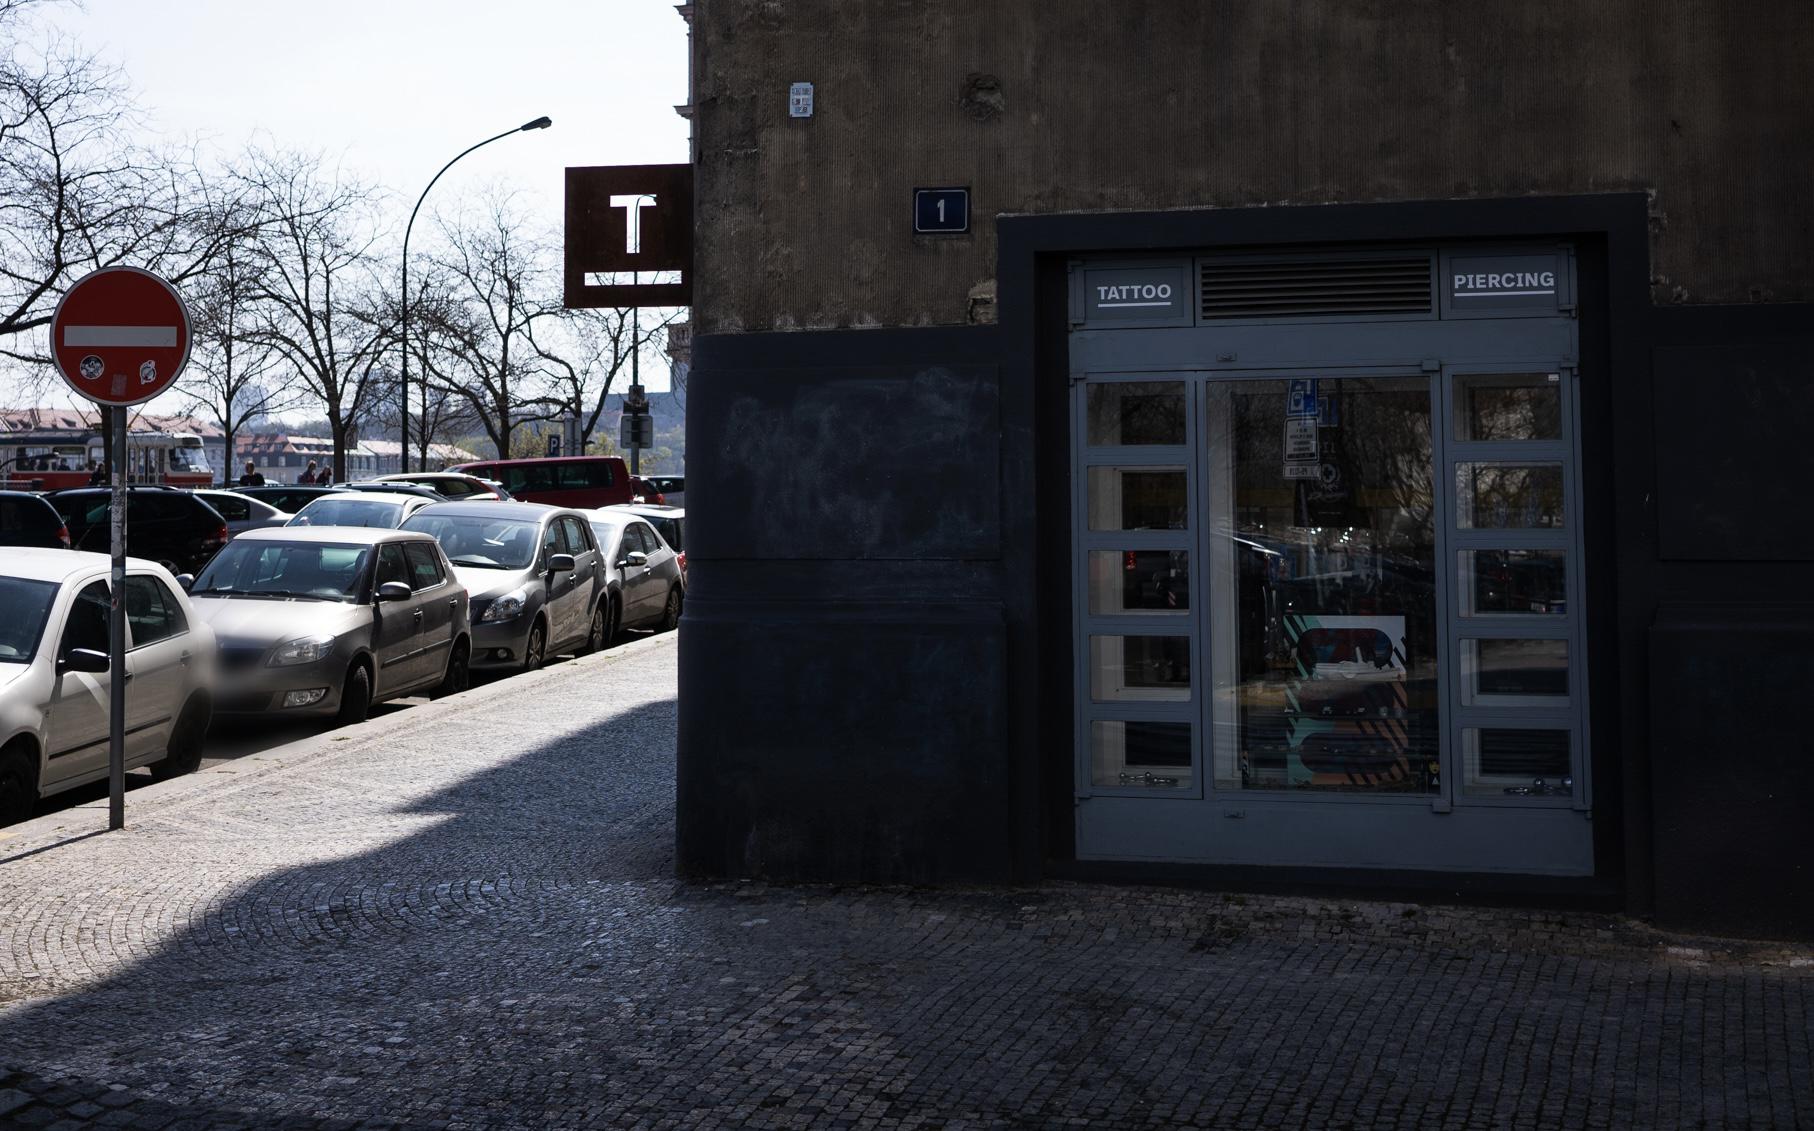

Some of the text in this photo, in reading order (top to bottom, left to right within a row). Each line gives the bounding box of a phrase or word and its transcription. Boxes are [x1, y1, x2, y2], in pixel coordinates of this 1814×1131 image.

[937, 198, 945, 223] 1
[610, 194, 657, 254] T
[1454, 271, 1554, 289] PIERCING
[1097, 284, 1171, 300] TATTOO
[550, 437, 559, 453] P
